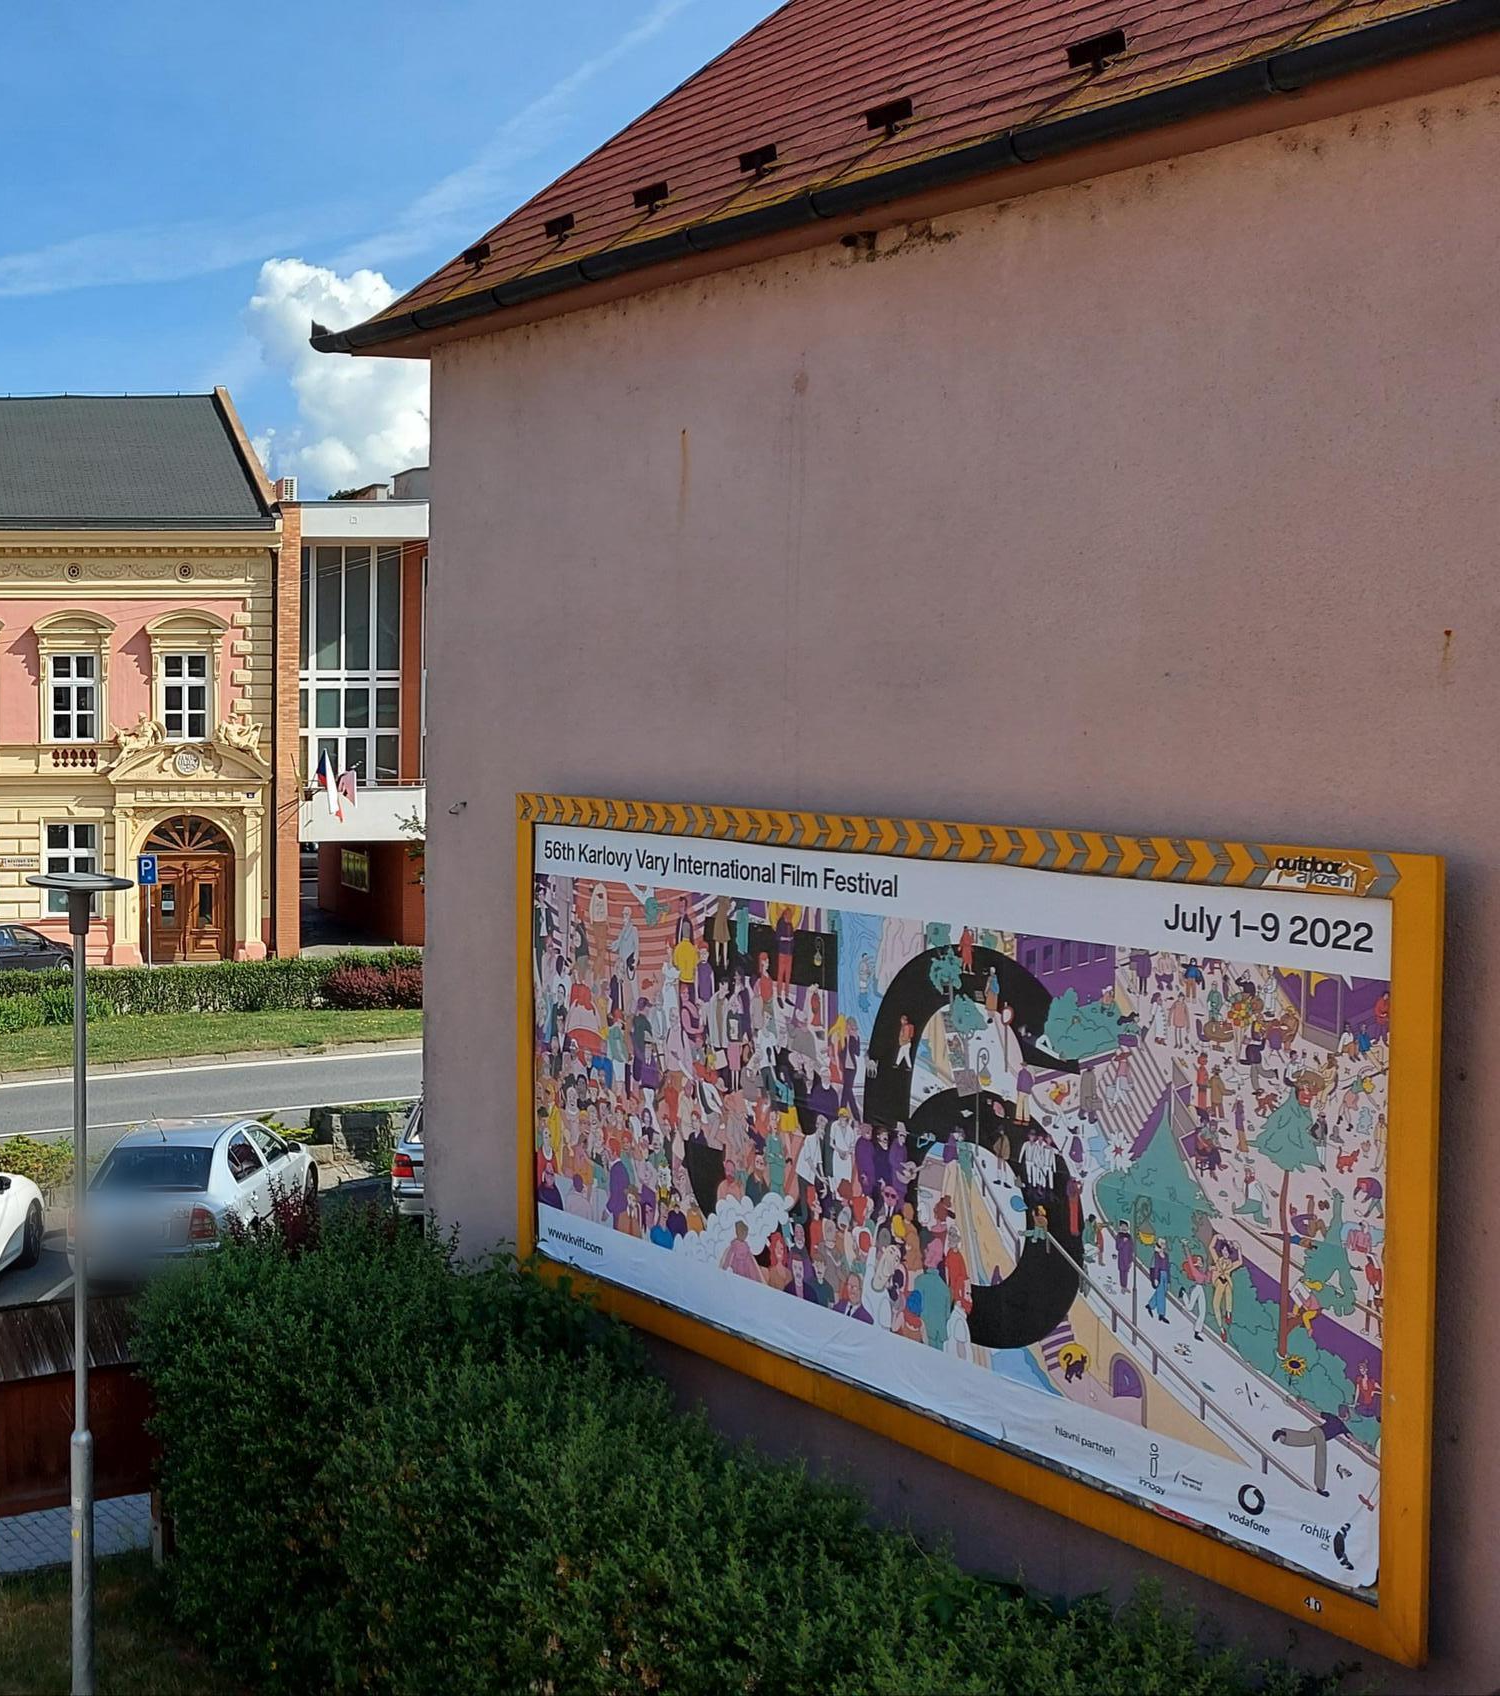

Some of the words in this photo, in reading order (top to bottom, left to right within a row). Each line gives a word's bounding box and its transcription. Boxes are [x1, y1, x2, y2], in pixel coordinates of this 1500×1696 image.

[141, 859, 153, 876] P
[544, 840, 575, 861] 56th
[578, 843, 632, 872] Karlovy
[635, 848, 670, 876] Vary
[673, 852, 776, 884] International
[781, 863, 818, 889] Film
[823, 867, 898, 898] Festival
[1164, 903, 1222, 942] July
[1288, 915, 1374, 953] 2022
[1054, 1425, 1080, 1443] hlavní
[1081, 1437, 1116, 1457] partneři
[1139, 1476, 1166, 1495] innogy
[1228, 1511, 1271, 1536] vodafone
[1300, 1523, 1332, 1542] rohlik
